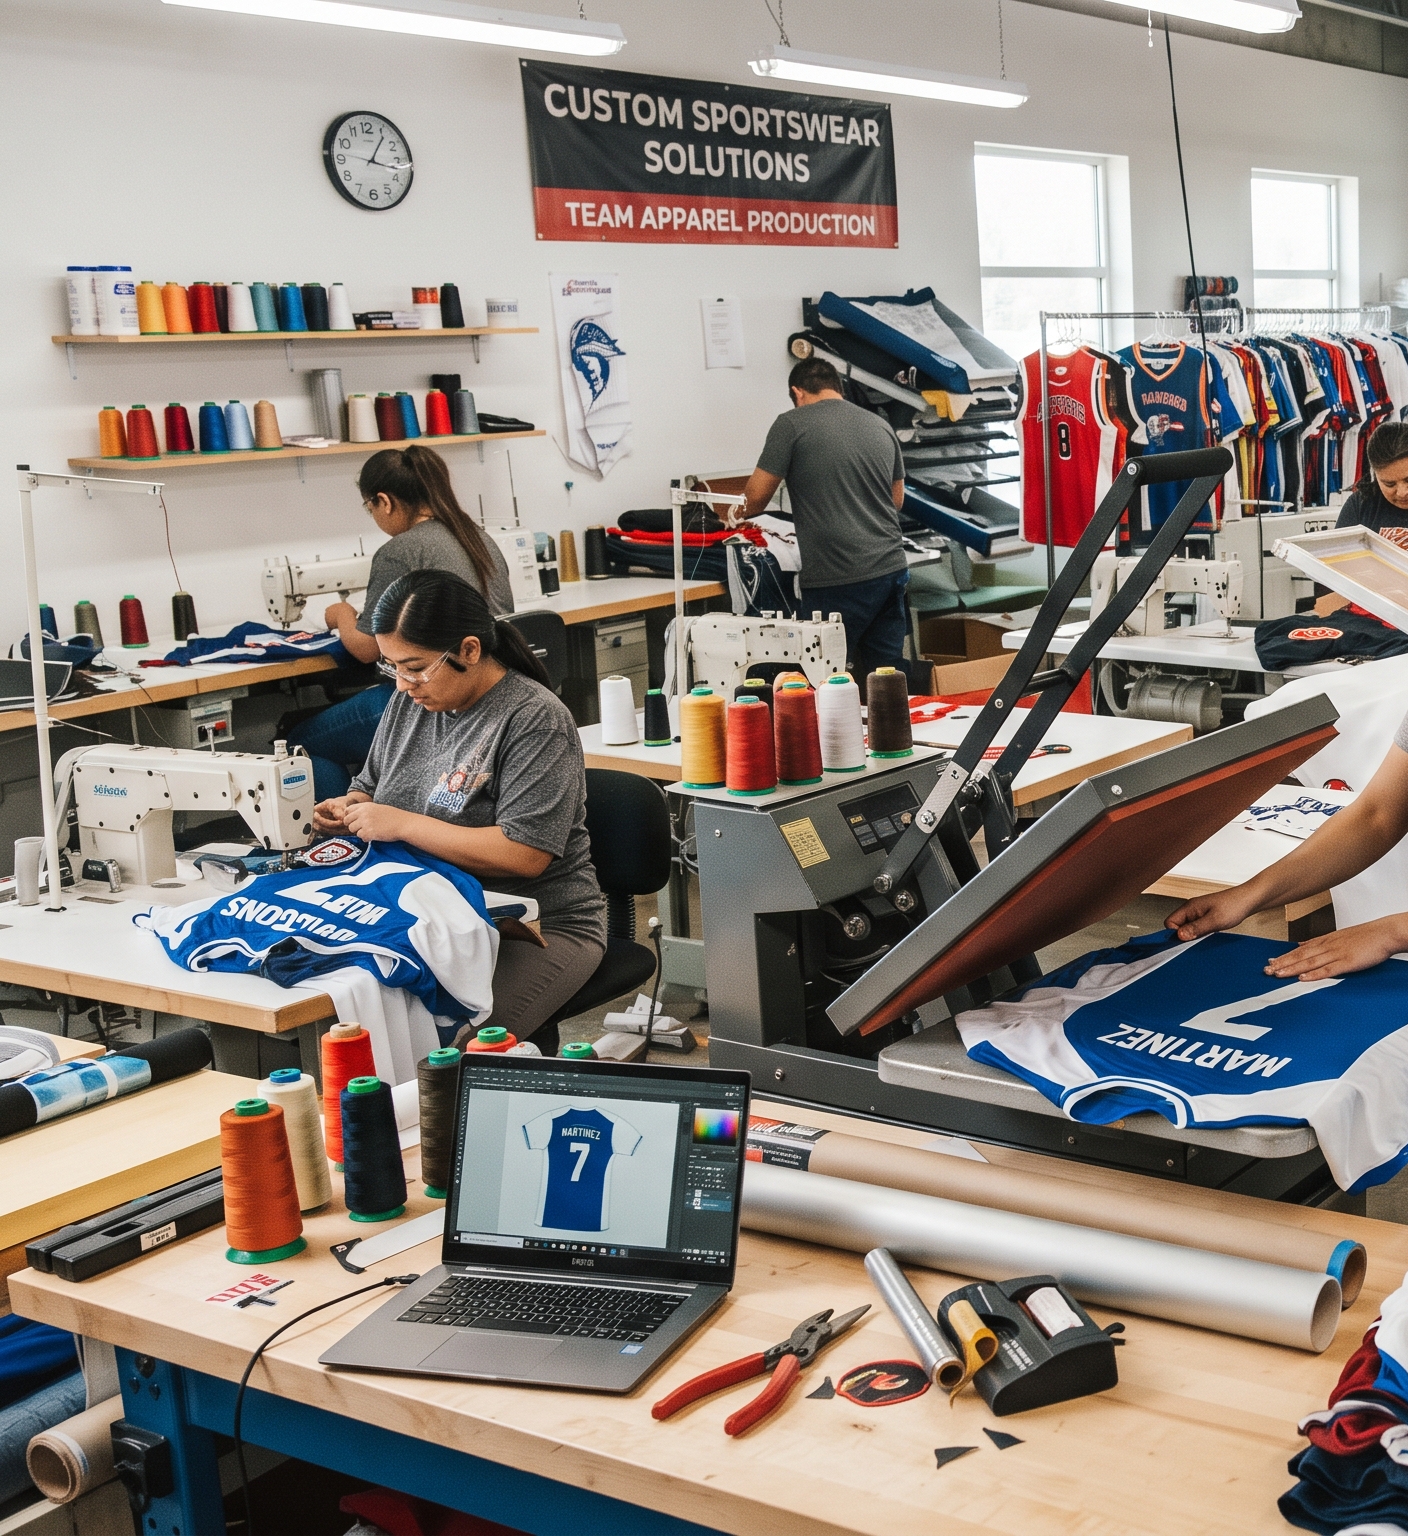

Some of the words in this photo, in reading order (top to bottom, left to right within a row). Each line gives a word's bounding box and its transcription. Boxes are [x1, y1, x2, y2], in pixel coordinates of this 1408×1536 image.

[544, 83, 683, 129] CUSTOM
[692, 100, 881, 147] SPORTSWEAR
[359, 122, 374, 134] 12
[338, 138, 351, 149] 10
[388, 141, 396, 152] 2
[336, 154, 346, 165] 9
[643, 140, 810, 183] SOLUTIONS
[343, 170, 352, 181] 8
[392, 173, 399, 182] 4
[355, 183, 362, 195] 7
[369, 189, 378, 200] 6
[383, 183, 391, 195] 5
[565, 201, 634, 228] TEAM
[640, 205, 743, 232] APPAREL
[747, 210, 875, 236] PRODUCTION
[1057, 422, 1071, 460] 8
[1180, 978, 1344, 1041] 7
[1097, 1023, 1292, 1077] MARTINEZ
[570, 1142, 590, 1182] 7
